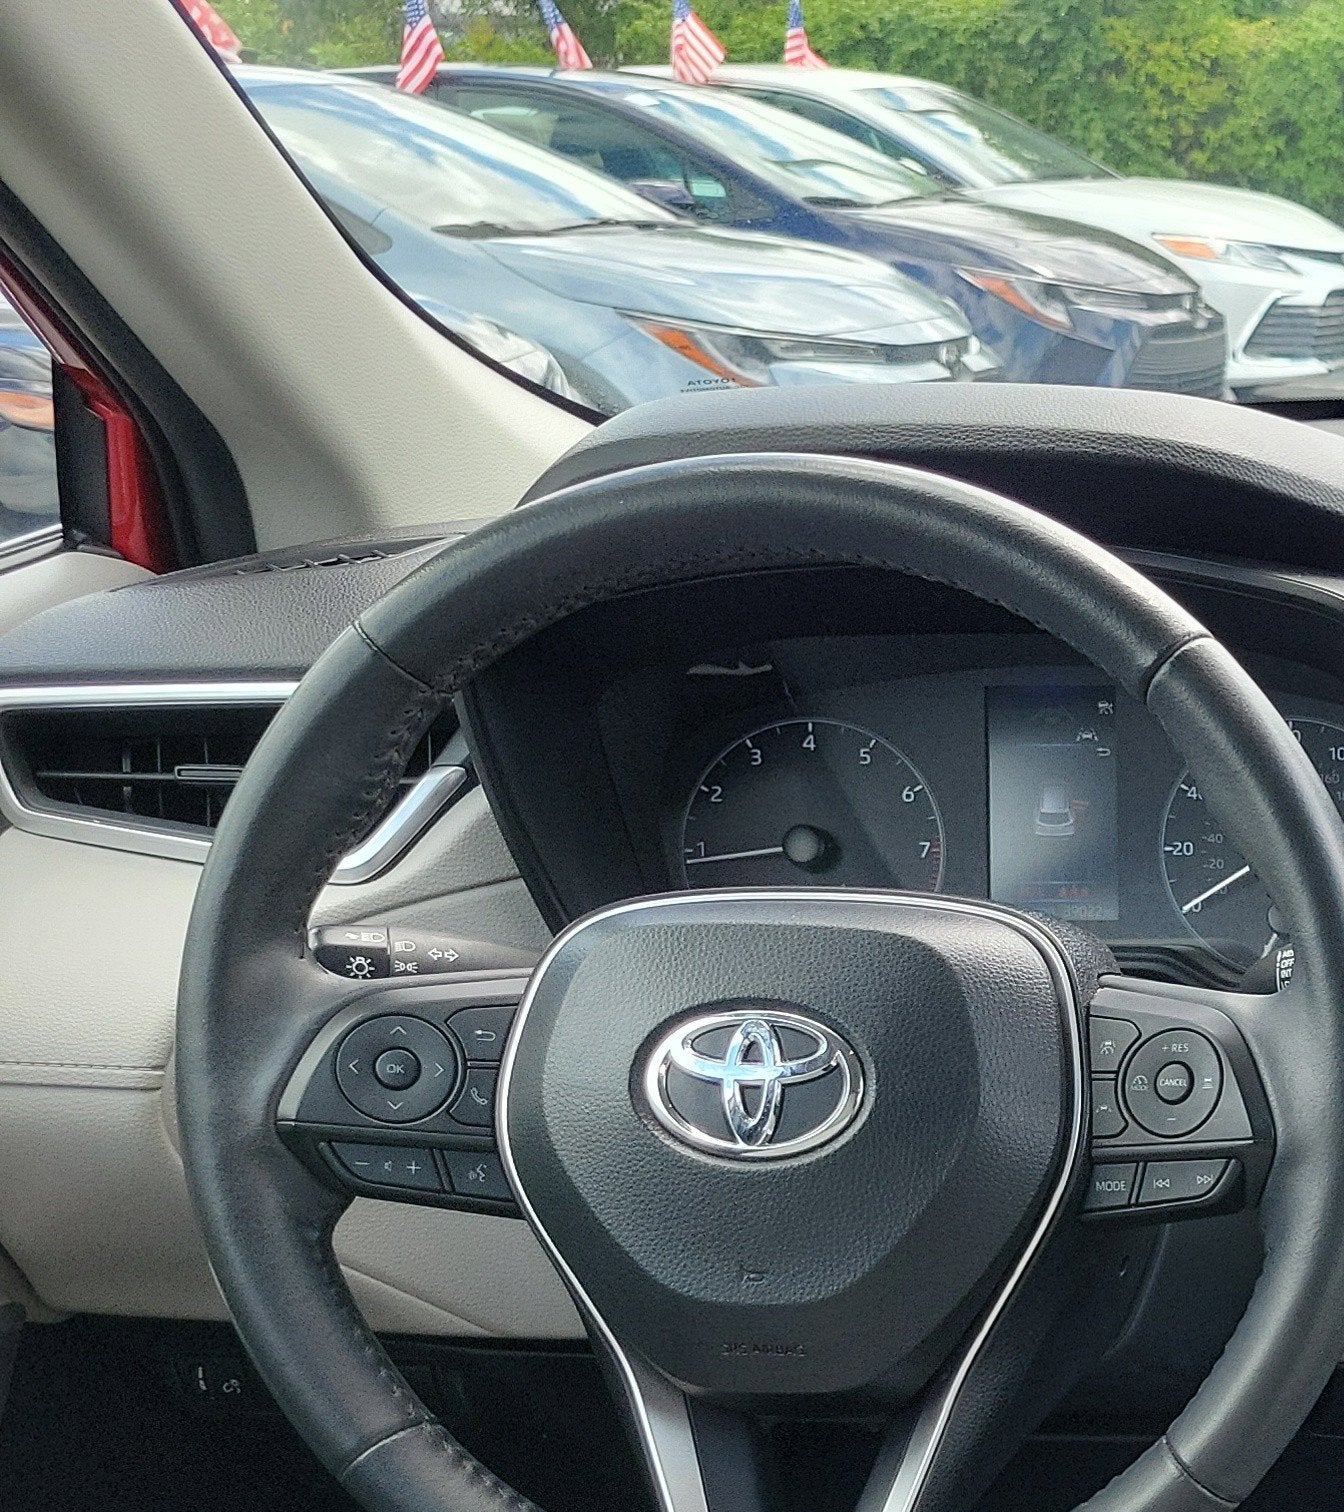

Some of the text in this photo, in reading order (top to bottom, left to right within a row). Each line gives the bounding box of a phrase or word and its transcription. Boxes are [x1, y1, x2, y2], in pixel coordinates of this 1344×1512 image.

[802, 735, 816, 751] 4
[750, 749, 762, 765] 3
[859, 749, 871, 764] 5
[710, 785, 723, 802] 2
[902, 786, 915, 802] 6
[1187, 786, 1202, 800] 4
[919, 842, 931, 858] 7
[1172, 842, 1194, 855] 20
[1171, 1043, 1189, 1053] RES
[386, 1064, 405, 1074] OK
[1160, 1079, 1187, 1087] CANCEL
[1095, 1181, 1127, 1192] MODE
